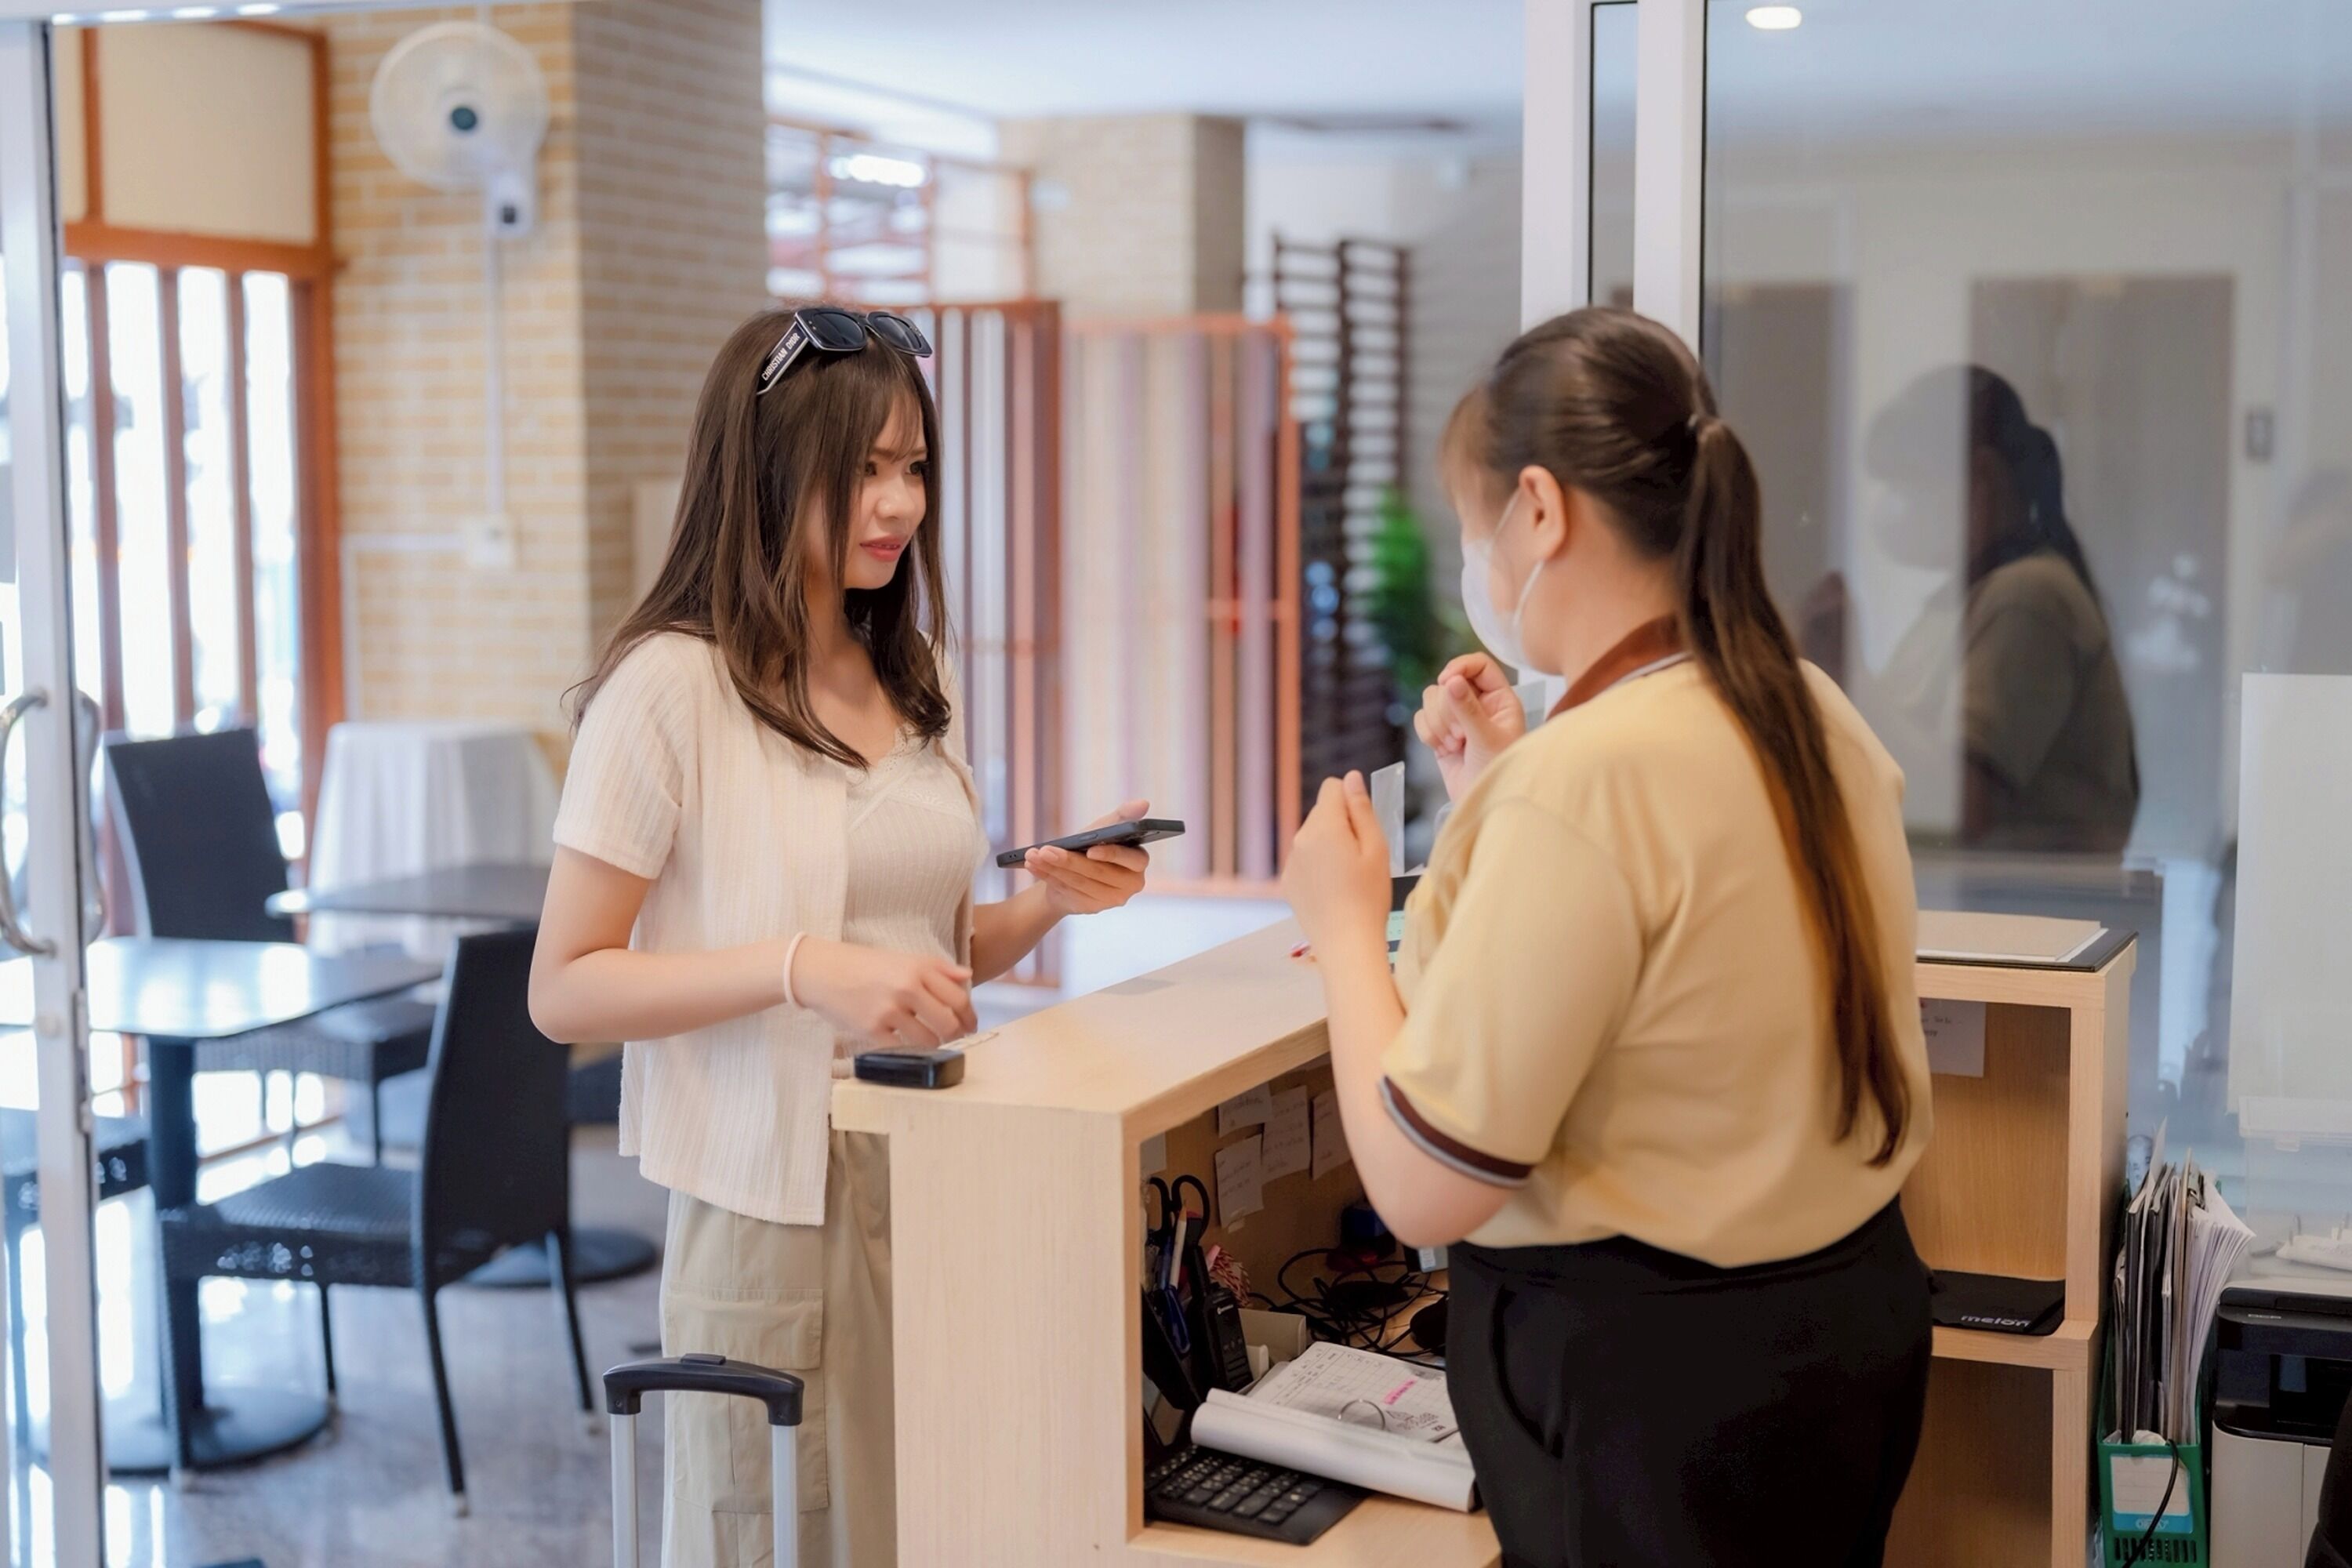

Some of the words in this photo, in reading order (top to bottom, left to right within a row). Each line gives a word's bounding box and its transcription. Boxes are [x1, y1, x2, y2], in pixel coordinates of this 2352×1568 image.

[761, 347, 788, 380] CHRISTIAN
[786, 332, 800, 350] DIOR
[1962, 1316, 2031, 1327] melon
